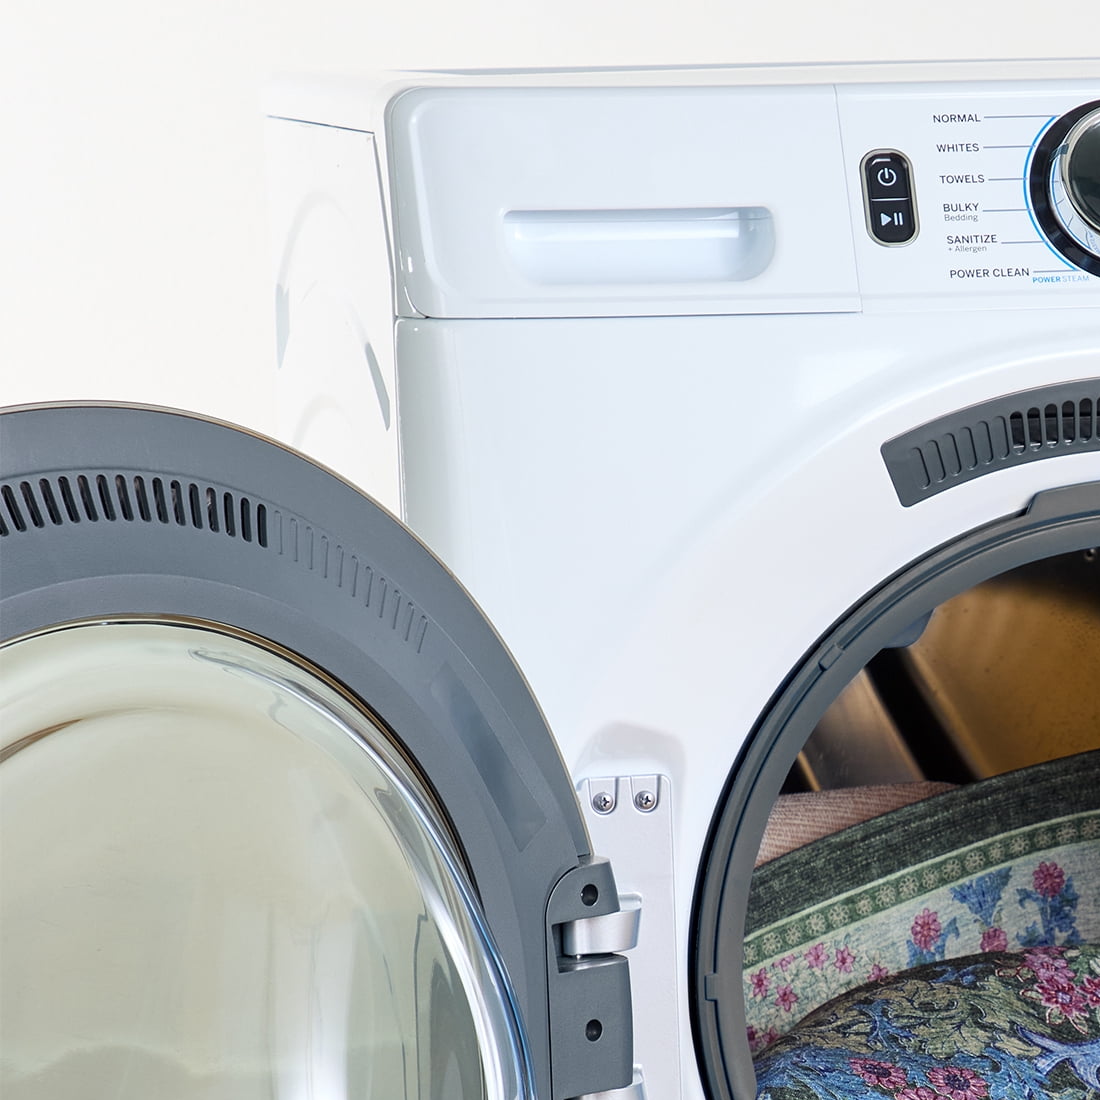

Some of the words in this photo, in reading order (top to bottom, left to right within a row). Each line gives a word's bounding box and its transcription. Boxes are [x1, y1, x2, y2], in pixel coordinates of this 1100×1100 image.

[933, 114, 980, 123] NORMAL
[937, 144, 979, 152] WHITES
[940, 174, 984, 184] TOWELS
[943, 203, 979, 212] BULKY
[944, 214, 978, 223] Bedding
[947, 234, 997, 244] SANITIZE
[955, 245, 987, 253] Allergen
[950, 269, 990, 278] POWER
[993, 268, 1029, 277] CLEAN
